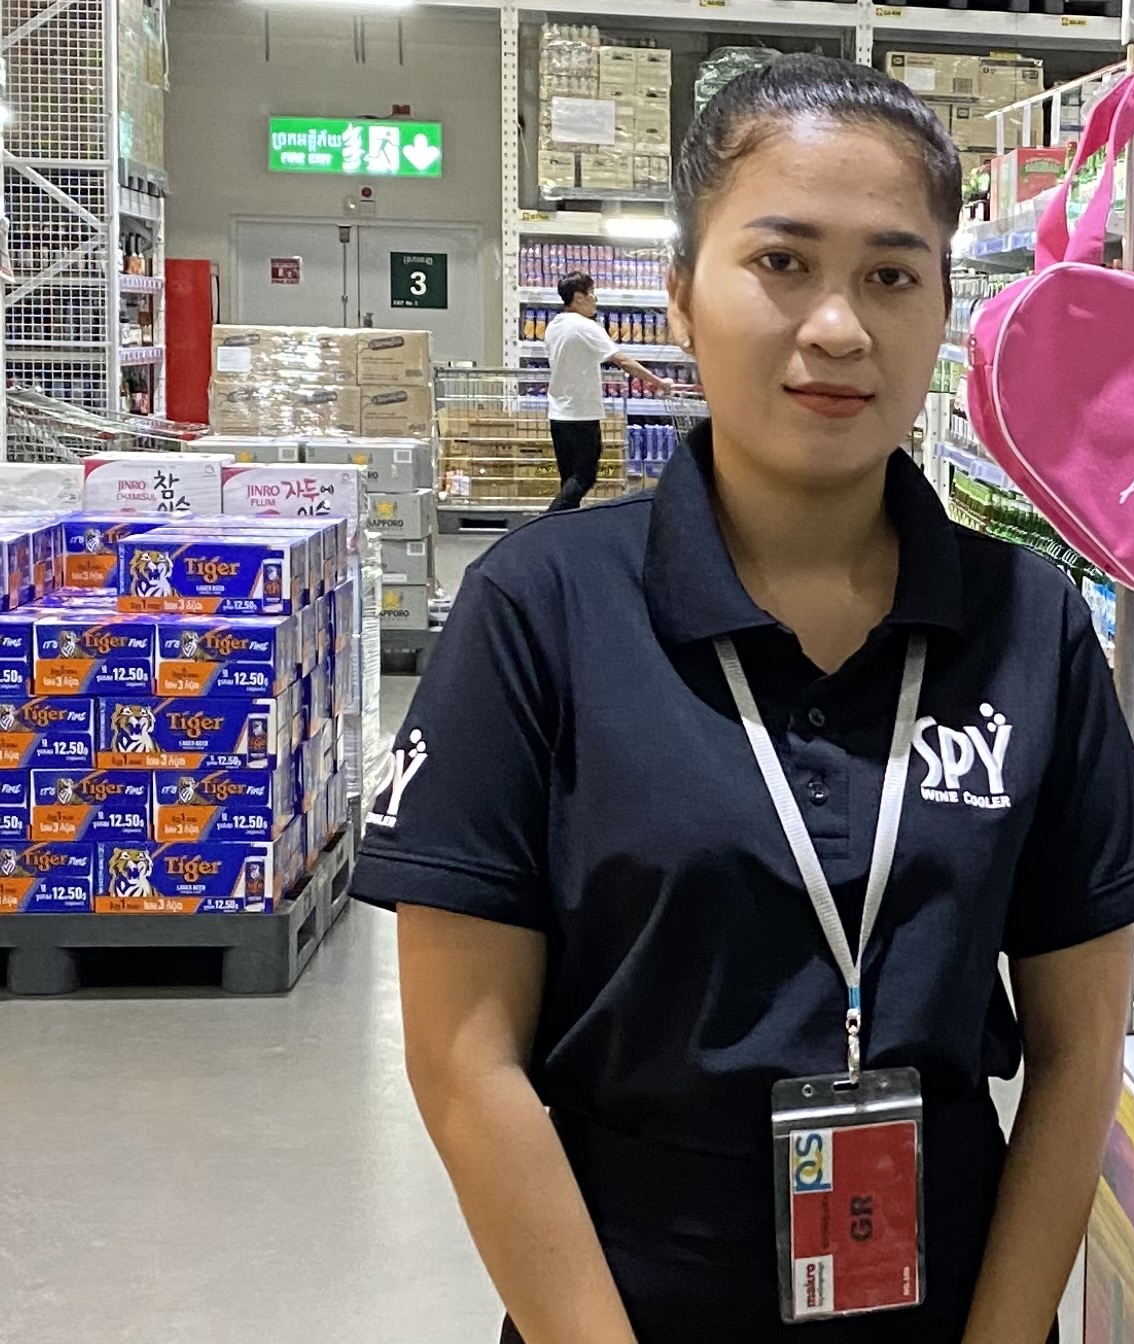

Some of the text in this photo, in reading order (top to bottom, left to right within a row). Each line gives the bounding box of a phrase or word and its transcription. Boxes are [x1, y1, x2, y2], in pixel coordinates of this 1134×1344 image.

[307, 153, 333, 165] EXIT
[410, 271, 427, 295] 3
[117, 480, 146, 492] JINRO
[153, 470, 180, 499] 참
[247, 484, 280, 499] JINRO
[183, 556, 241, 583] Tiger
[82, 628, 127, 654] Tiger
[204, 629, 249, 654] Tiger
[23, 704, 67, 730] Tiger
[167, 709, 224, 738] Tiger
[910, 712, 1013, 794] SPY
[80, 777, 125, 800] Tiger
[201, 777, 246, 800] Tiger
[920, 787, 1012, 809] WINE COOLER
[24, 850, 68, 871] Tiger
[164, 854, 222, 883] Tiger
